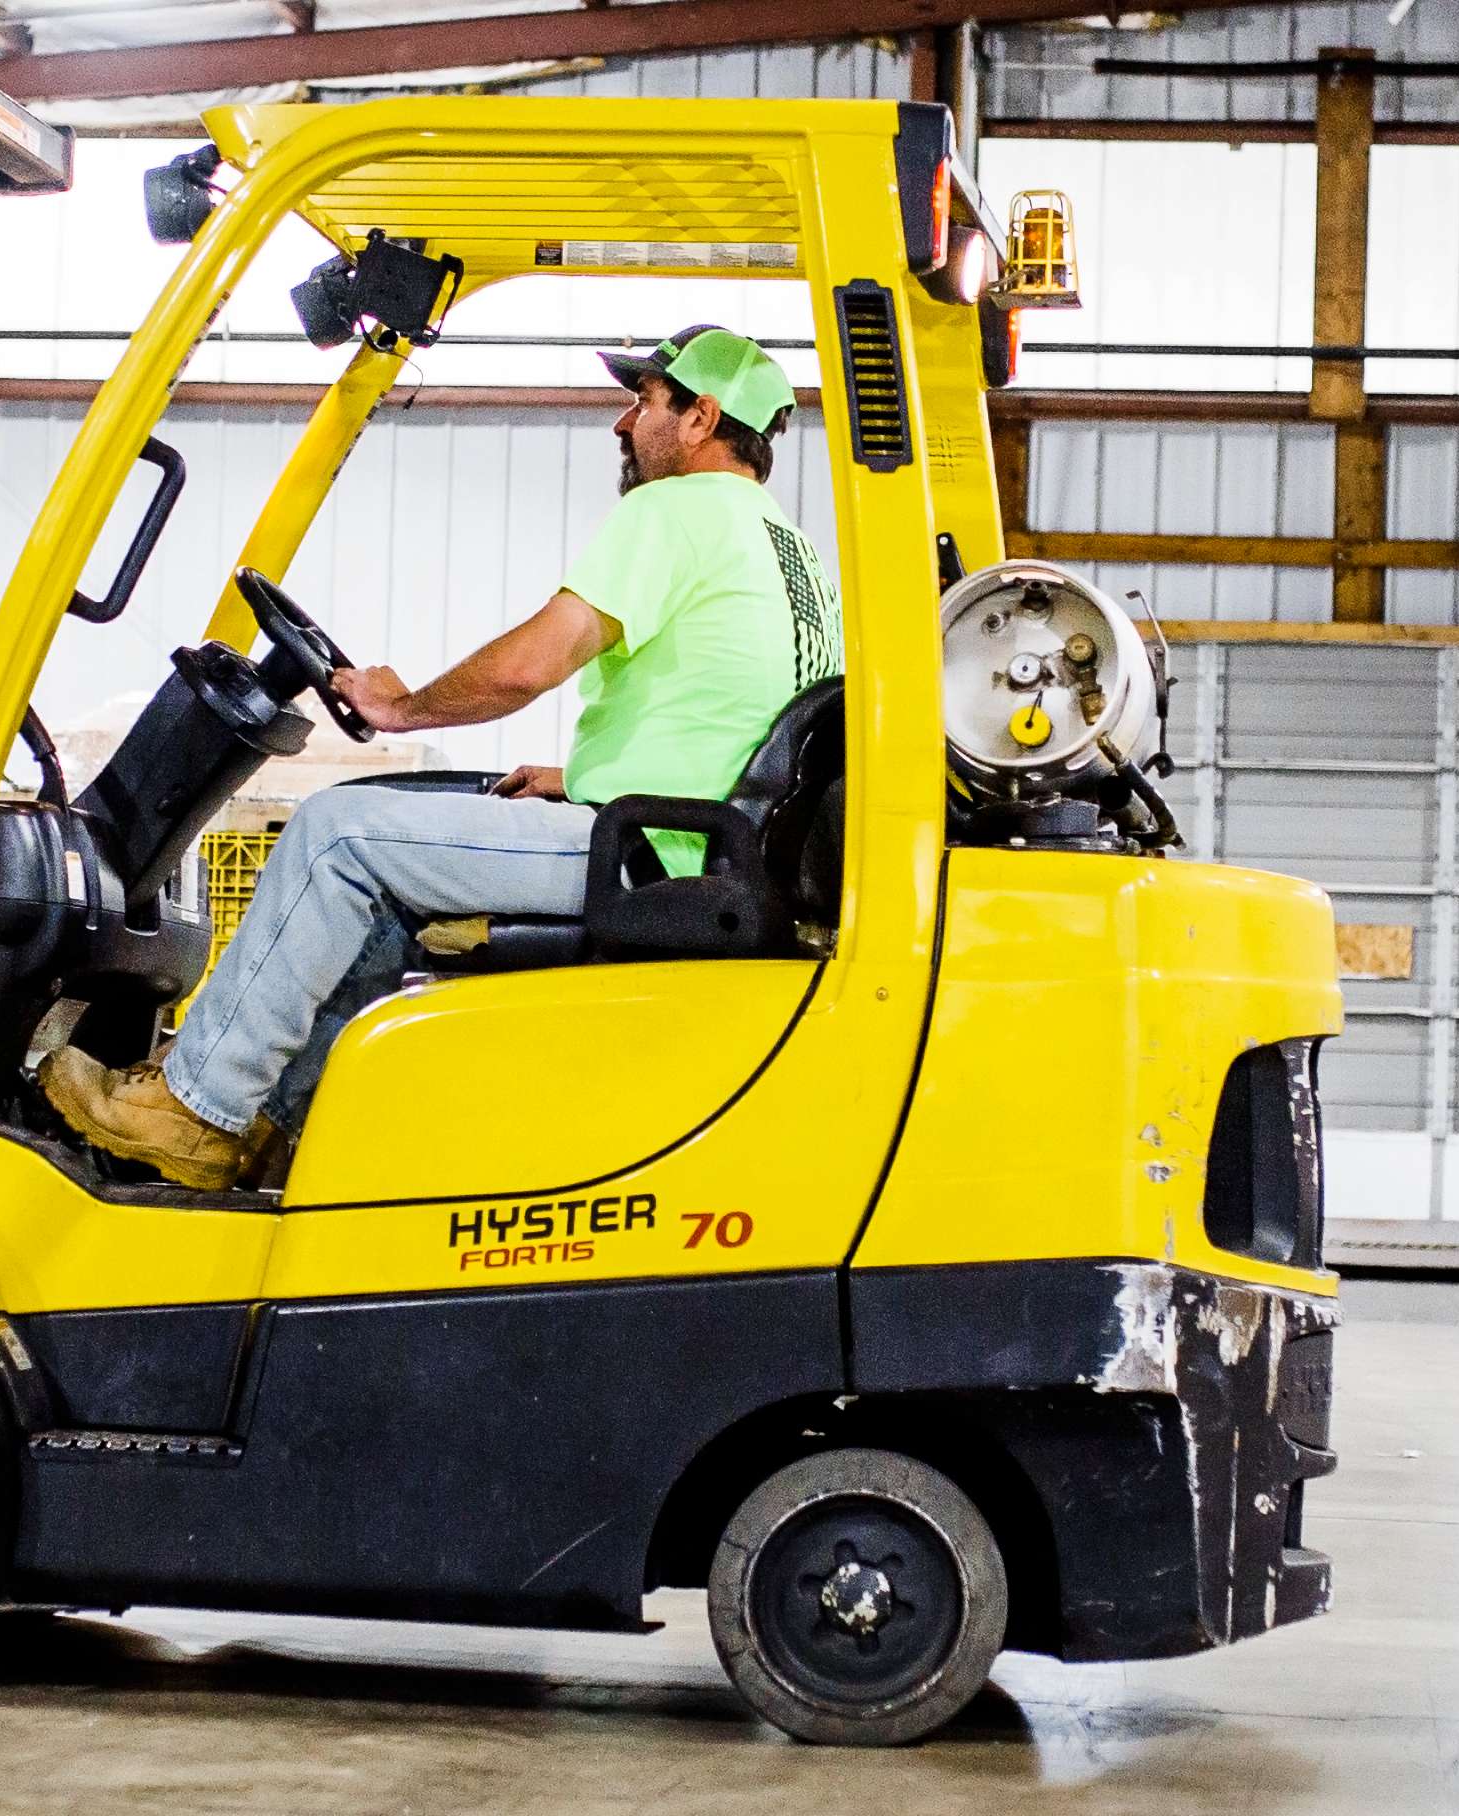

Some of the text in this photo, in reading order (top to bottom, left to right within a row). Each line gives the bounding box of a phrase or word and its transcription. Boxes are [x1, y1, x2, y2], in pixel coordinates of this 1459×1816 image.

[448, 1193, 754, 1249] HYSTER 70
[459, 1240, 594, 1271] FORTIS
